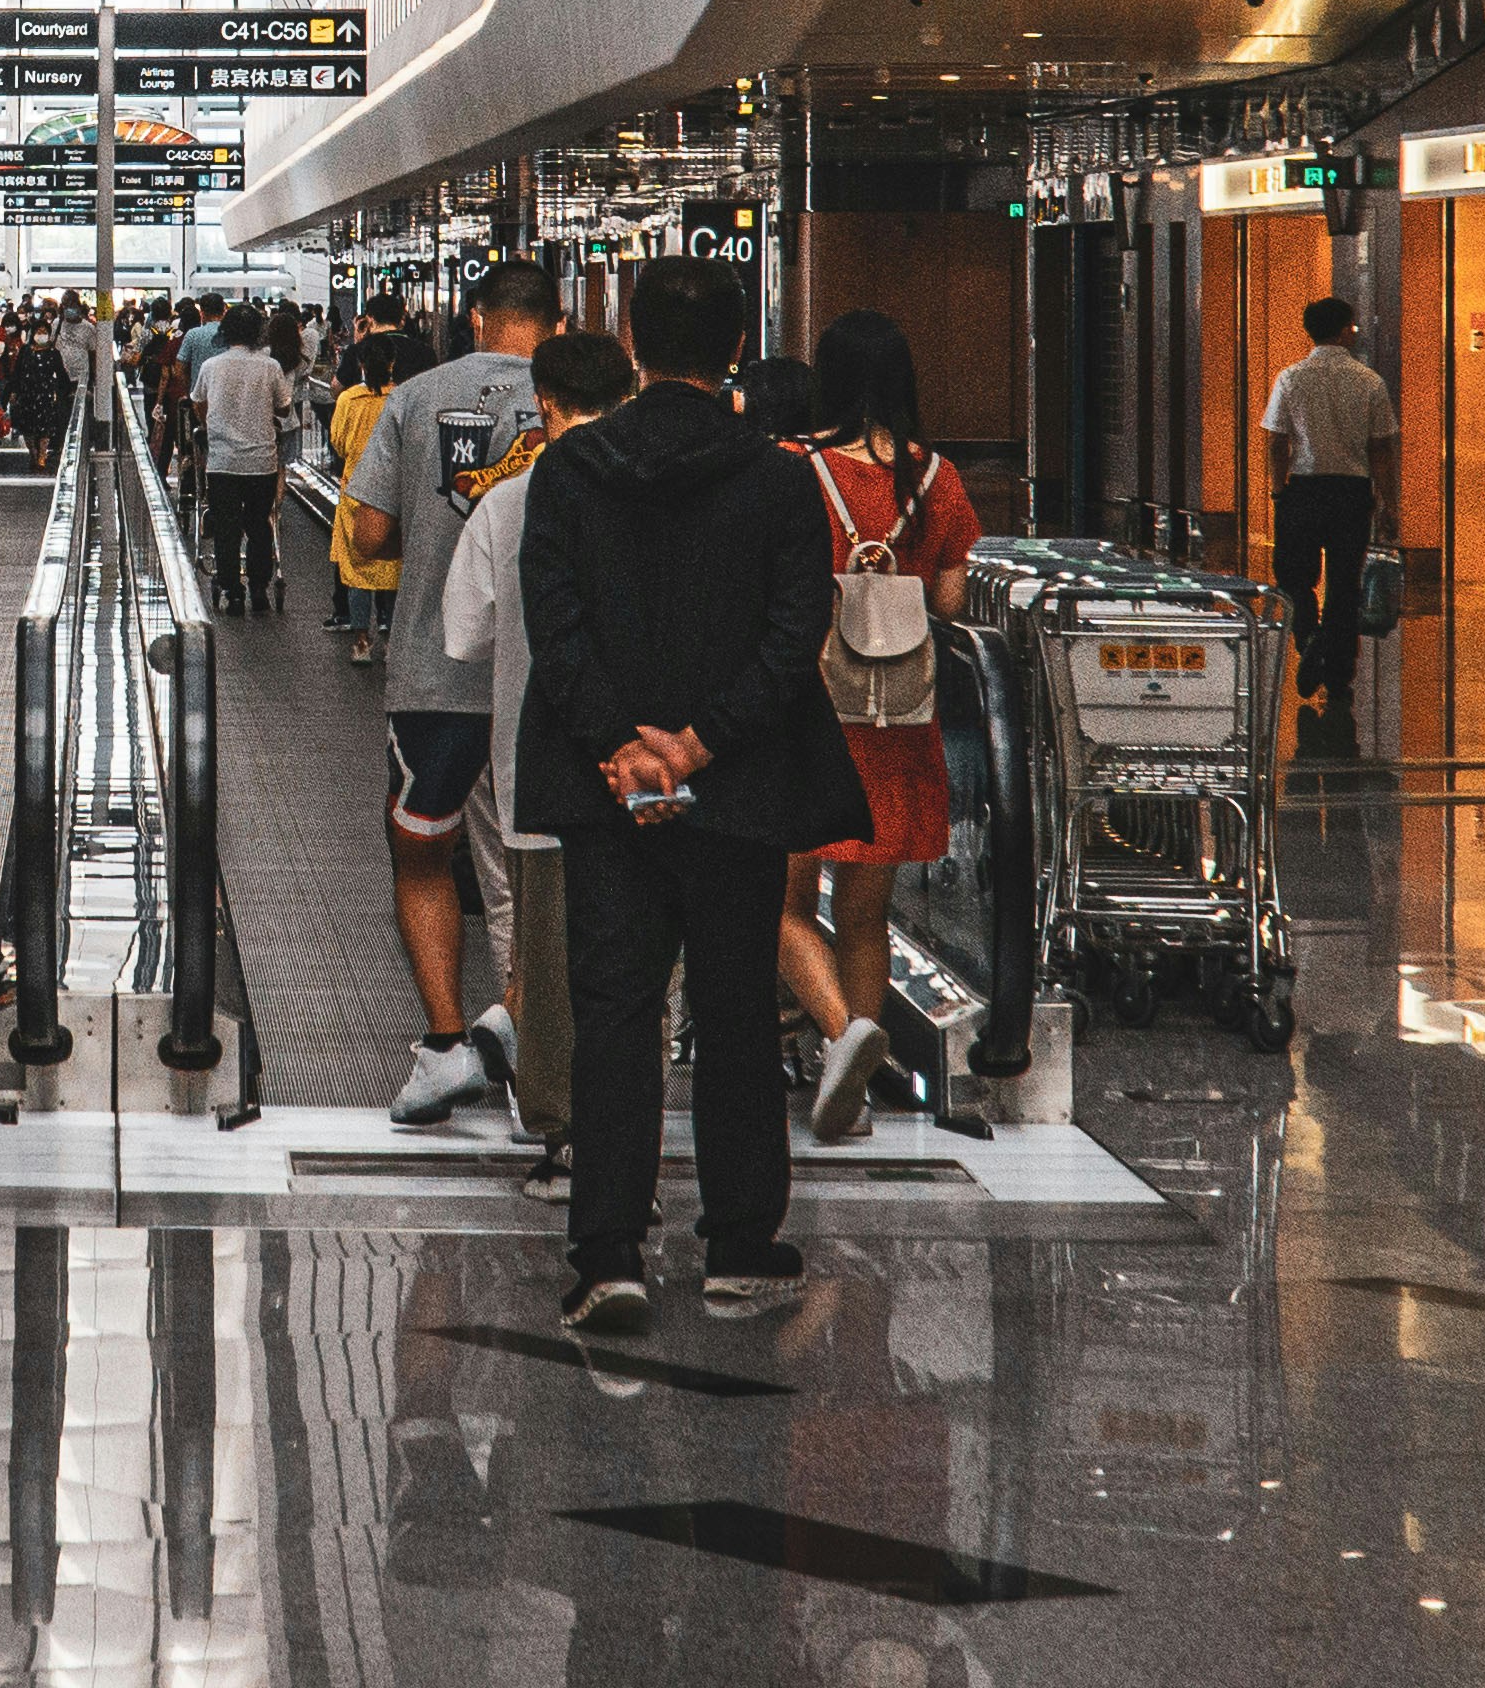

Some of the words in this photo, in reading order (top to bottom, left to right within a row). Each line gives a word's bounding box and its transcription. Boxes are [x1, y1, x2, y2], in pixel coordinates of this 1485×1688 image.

[21, 21, 88, 38] Courtyard
[220, 20, 308, 40] C41-C56
[24, 70, 82, 87] Nursery
[140, 68, 175, 77] Airlines
[210, 68, 308, 88] 贵宾休息室
[139, 79, 175, 90] Lounge
[166, 149, 214, 161] C42-C55
[154, 175, 185, 186] 洗手间
[690, 227, 753, 262] C40
[332, 273, 356, 289] C42
